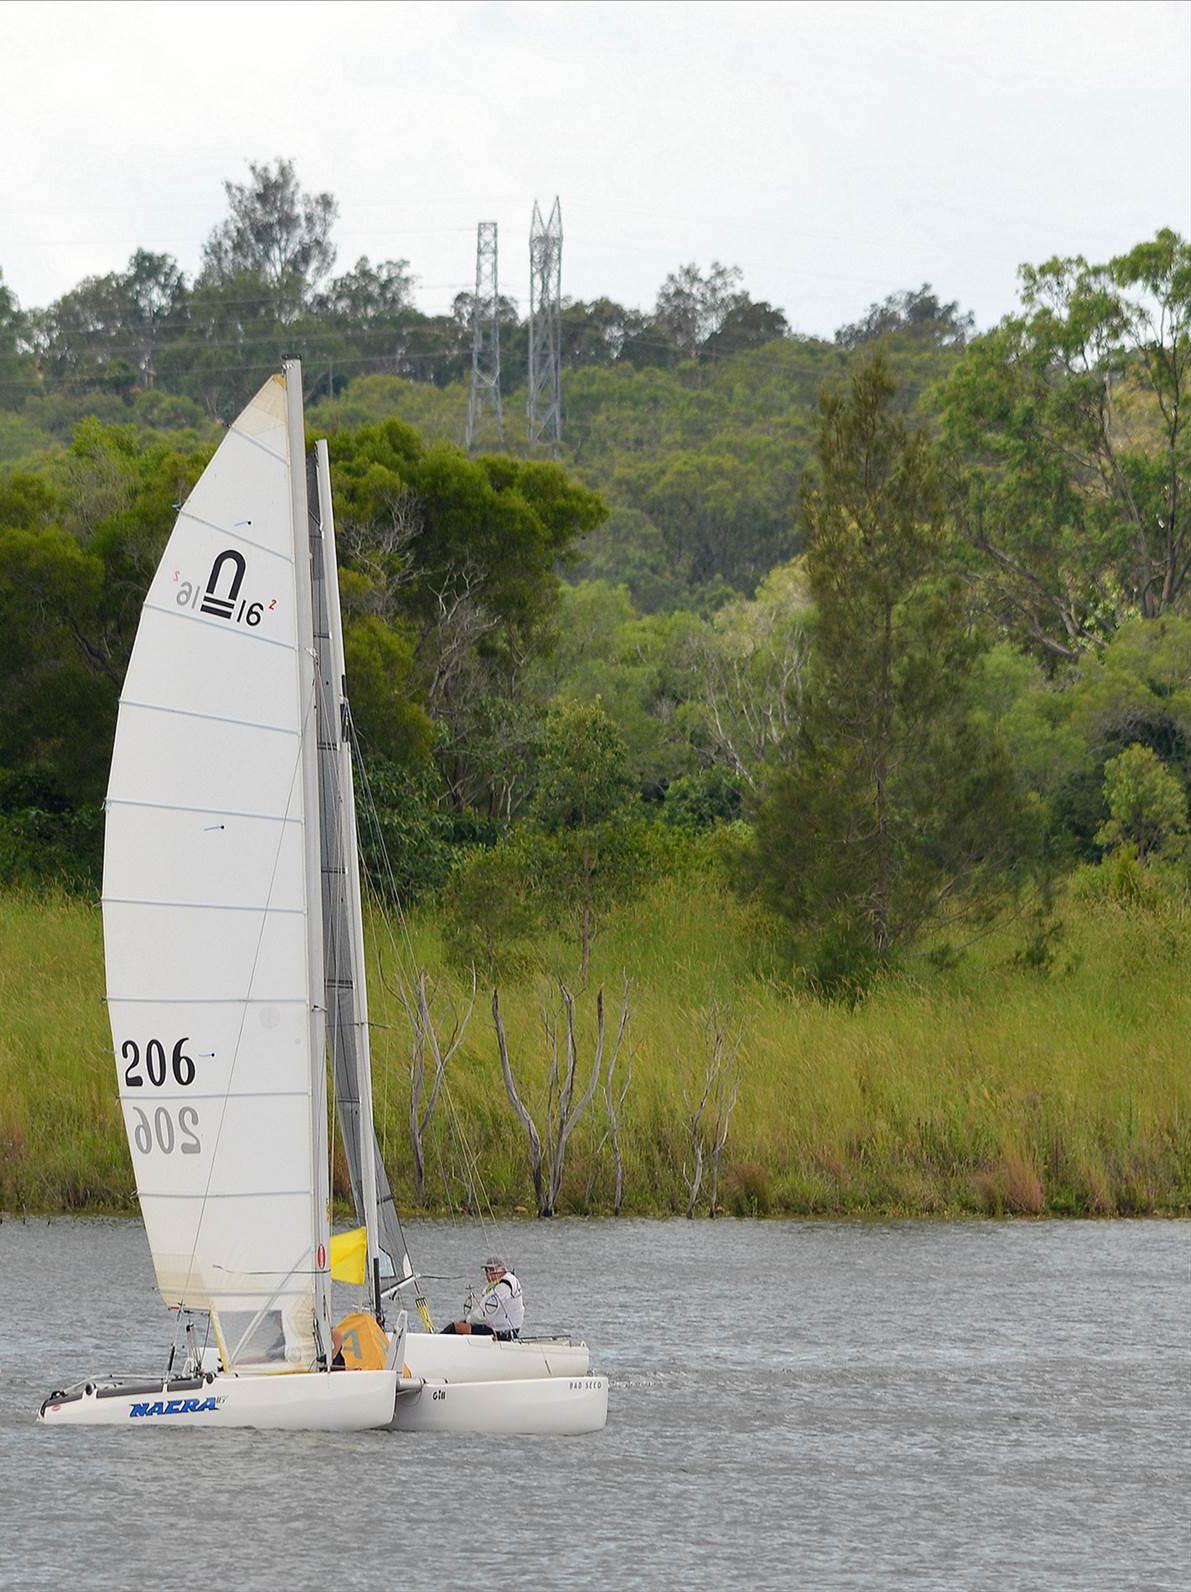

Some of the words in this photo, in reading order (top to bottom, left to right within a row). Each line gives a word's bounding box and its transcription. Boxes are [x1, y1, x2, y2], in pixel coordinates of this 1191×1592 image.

[236, 599, 264, 627] 16
[121, 1037, 196, 1087] 206
[129, 1397, 219, 1418] NACRA
